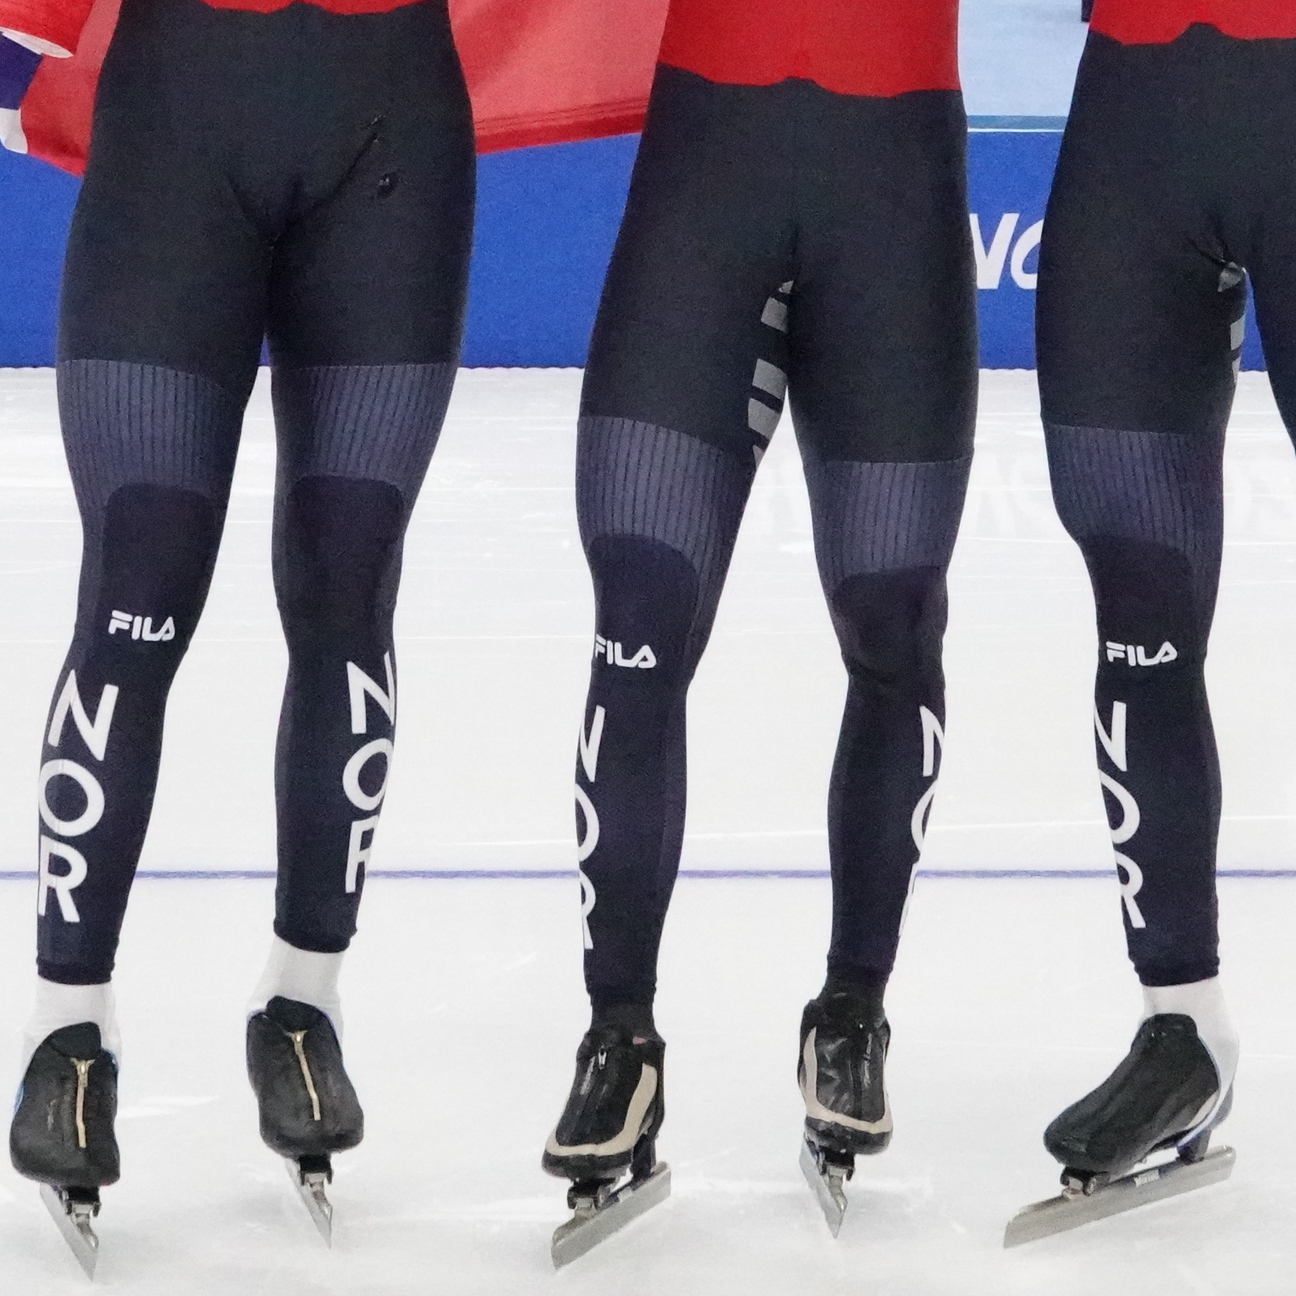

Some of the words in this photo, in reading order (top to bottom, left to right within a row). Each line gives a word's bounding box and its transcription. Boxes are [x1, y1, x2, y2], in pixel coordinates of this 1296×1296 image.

[108, 610, 176, 642] FILA
[594, 633, 657, 669] FILA
[1105, 640, 1178, 667] FILA
[38, 668, 119, 923] NOR
